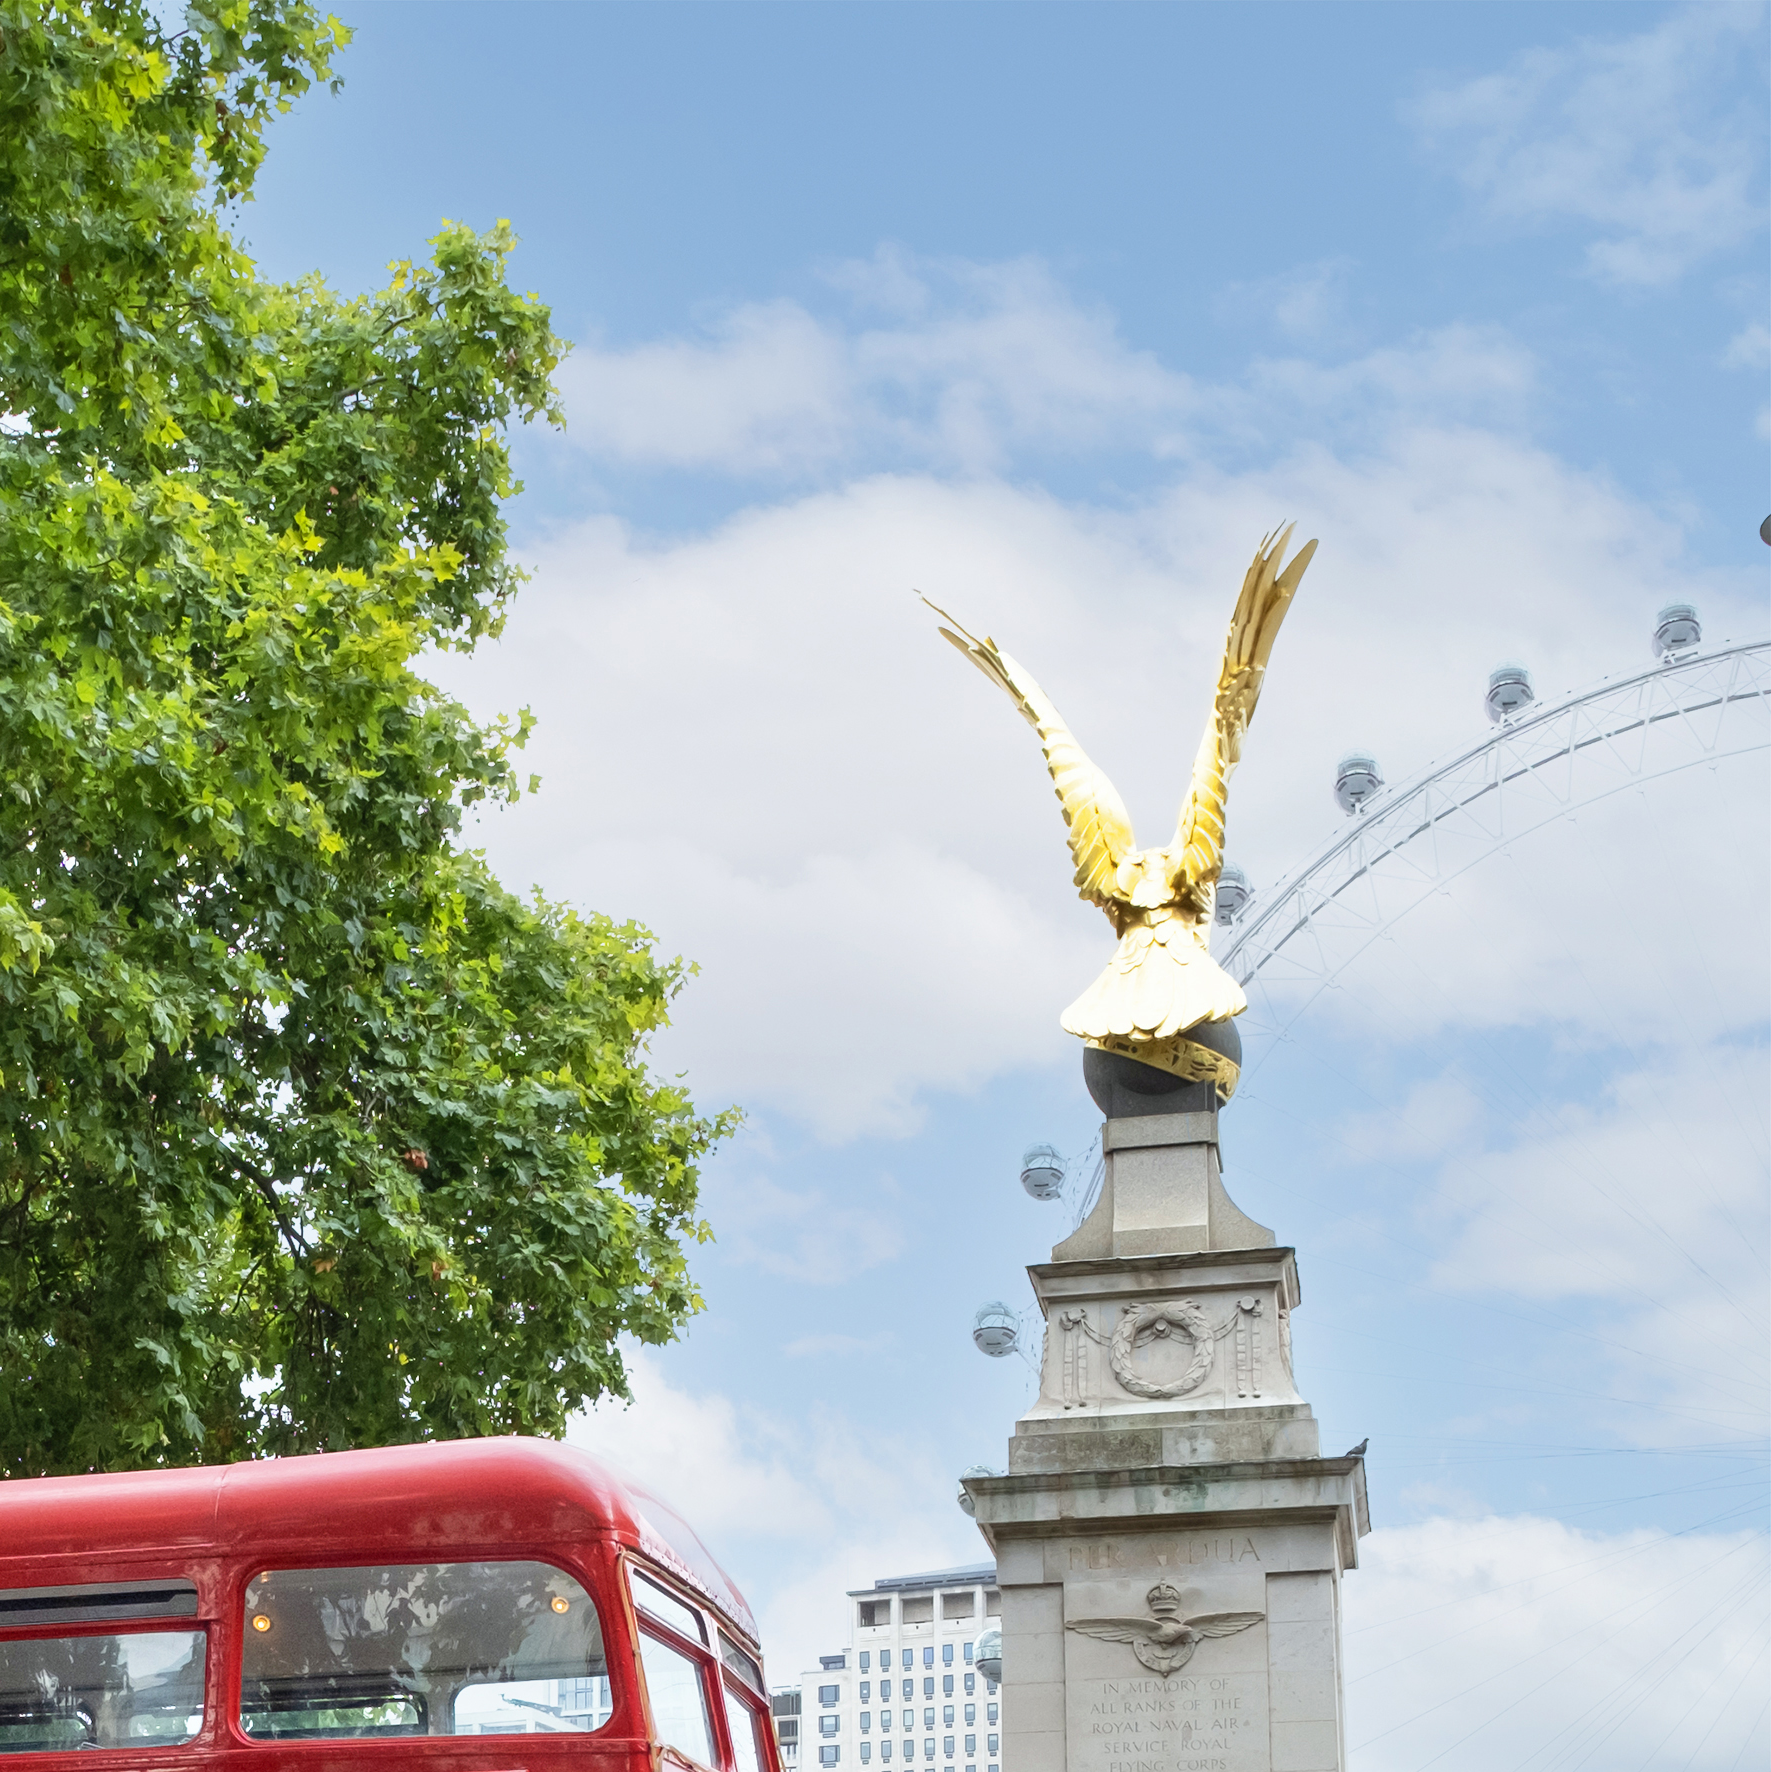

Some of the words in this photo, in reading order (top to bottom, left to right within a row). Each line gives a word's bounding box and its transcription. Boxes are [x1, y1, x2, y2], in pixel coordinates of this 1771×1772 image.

[1103, 1683, 1119, 1694] IN
[1129, 1679, 1200, 1694] MEMORY
[1209, 1678, 1230, 1690] OF
[1090, 1703, 1117, 1714] ALL
[1124, 1700, 1175, 1713] RANKS
[1183, 1700, 1200, 1711] OF
[1213, 1698, 1241, 1710] THE
[1092, 1722, 1141, 1734] ROYAL
[1150, 1720, 1202, 1731] NAVAL
[1211, 1718, 1239, 1729] AIR
[1104, 1740, 1168, 1753] SERVICE
[1181, 1738, 1231, 1751] ROYAL
[1110, 1761, 1164, 1772] FLYING
[1177, 1759, 1227, 1771] CORPS
